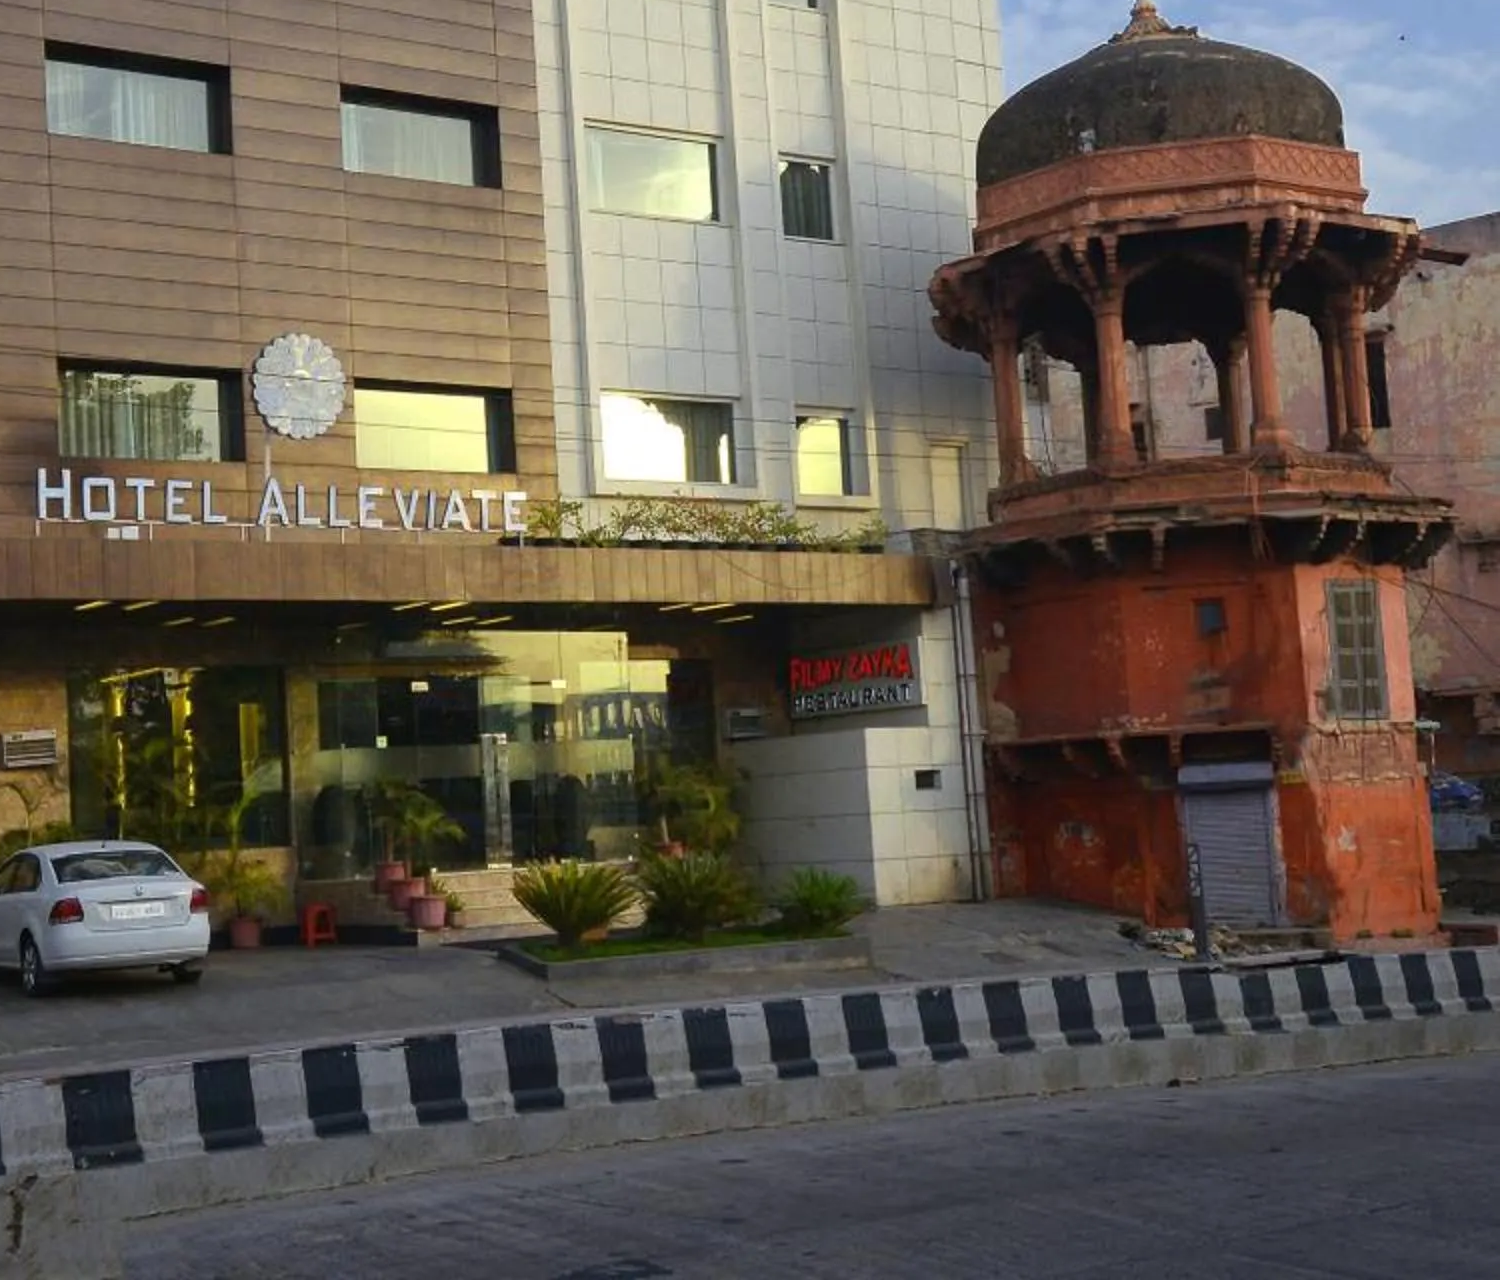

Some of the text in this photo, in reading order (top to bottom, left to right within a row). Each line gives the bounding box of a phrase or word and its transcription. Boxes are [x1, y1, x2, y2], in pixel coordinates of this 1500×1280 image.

[36, 467, 528, 532] HOTEL ALLEVIATE
[790, 656, 844, 693] FILMY
